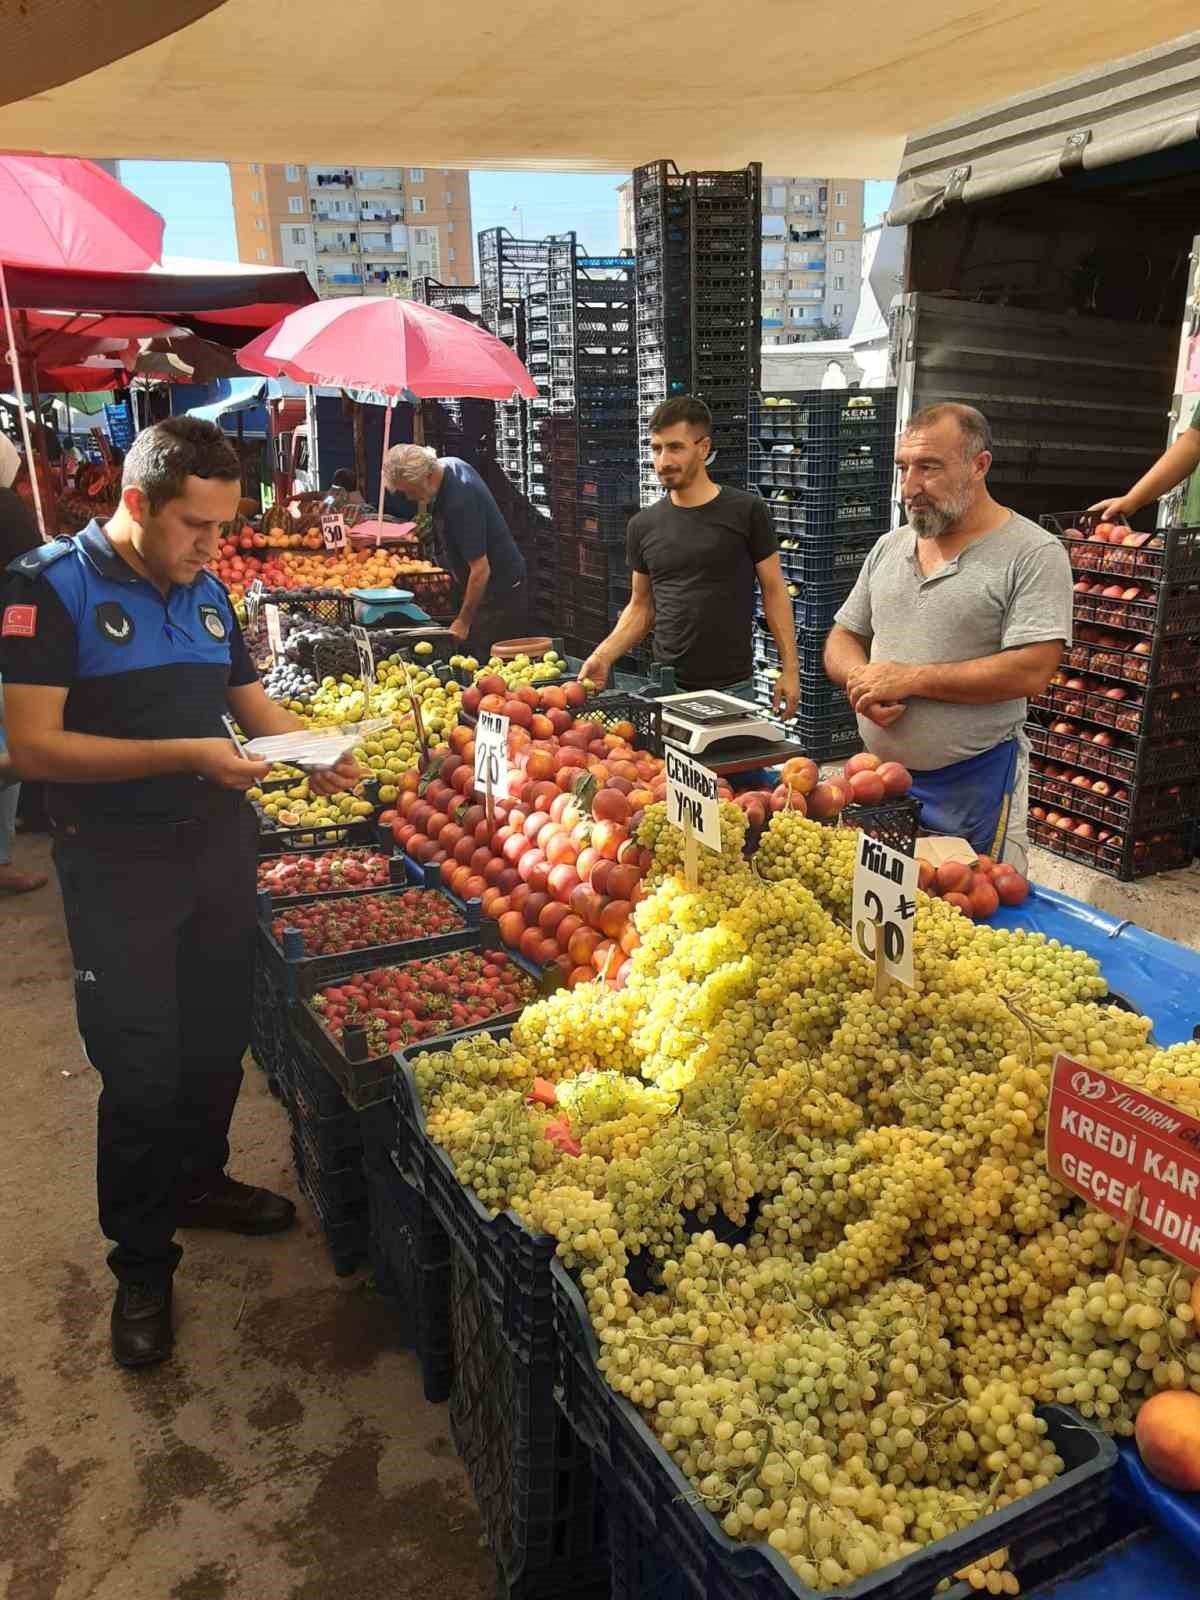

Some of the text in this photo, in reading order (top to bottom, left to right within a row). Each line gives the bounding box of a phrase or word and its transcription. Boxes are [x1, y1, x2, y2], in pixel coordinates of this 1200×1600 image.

[841, 408, 877, 417] KENT
[325, 525, 343, 543] 30
[478, 743, 500, 784] 25
[674, 788, 704, 833] YOK
[856, 890, 905, 965] 30
[1109, 1086, 1182, 1133] YILDIRIM
[1060, 1106, 1200, 1200] KREDİ KAR
